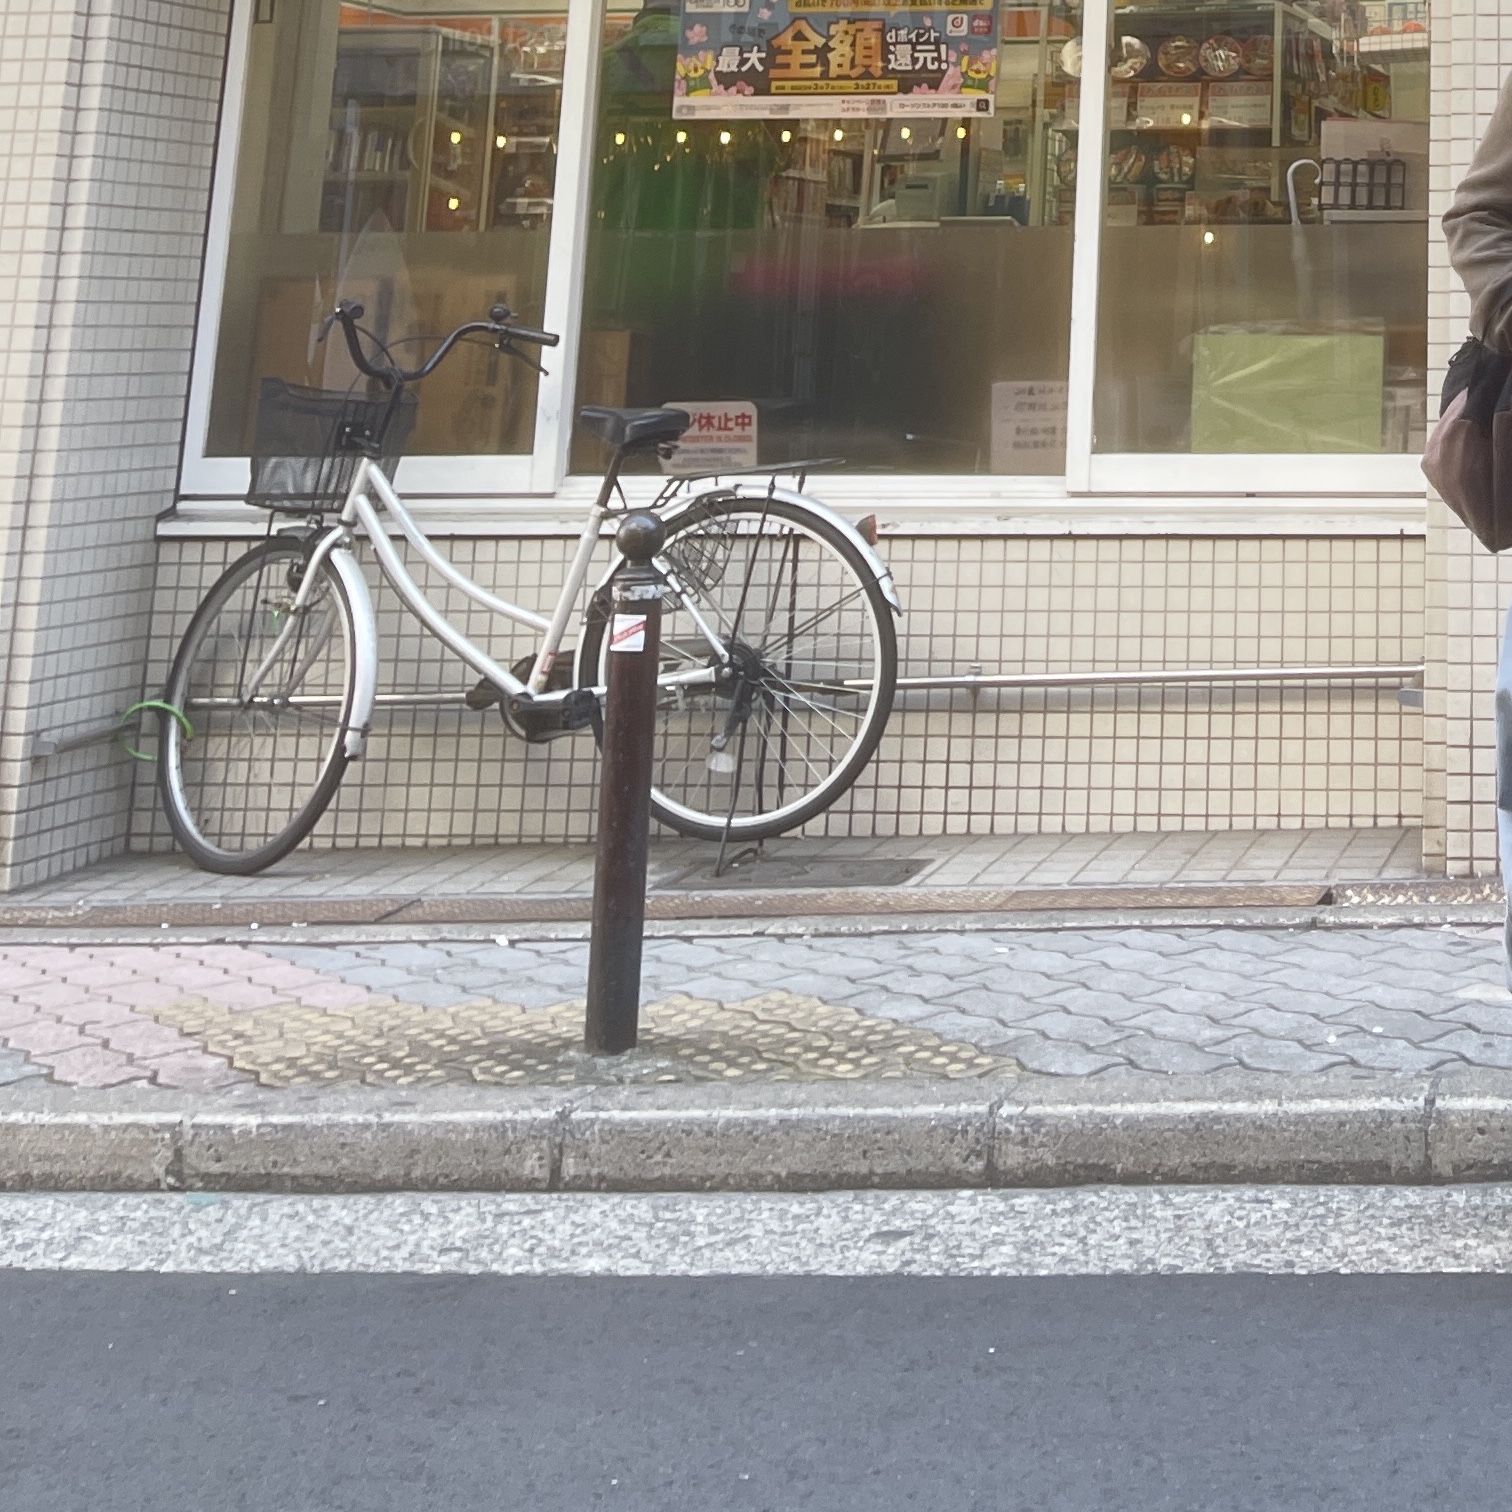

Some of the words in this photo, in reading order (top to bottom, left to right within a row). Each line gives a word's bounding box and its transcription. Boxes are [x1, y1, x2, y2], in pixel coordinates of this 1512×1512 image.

[716, 45, 767, 73] 最大
[768, 18, 884, 79] 全額
[886, 27, 940, 43] dポイント
[887, 43, 949, 71] 還元!
